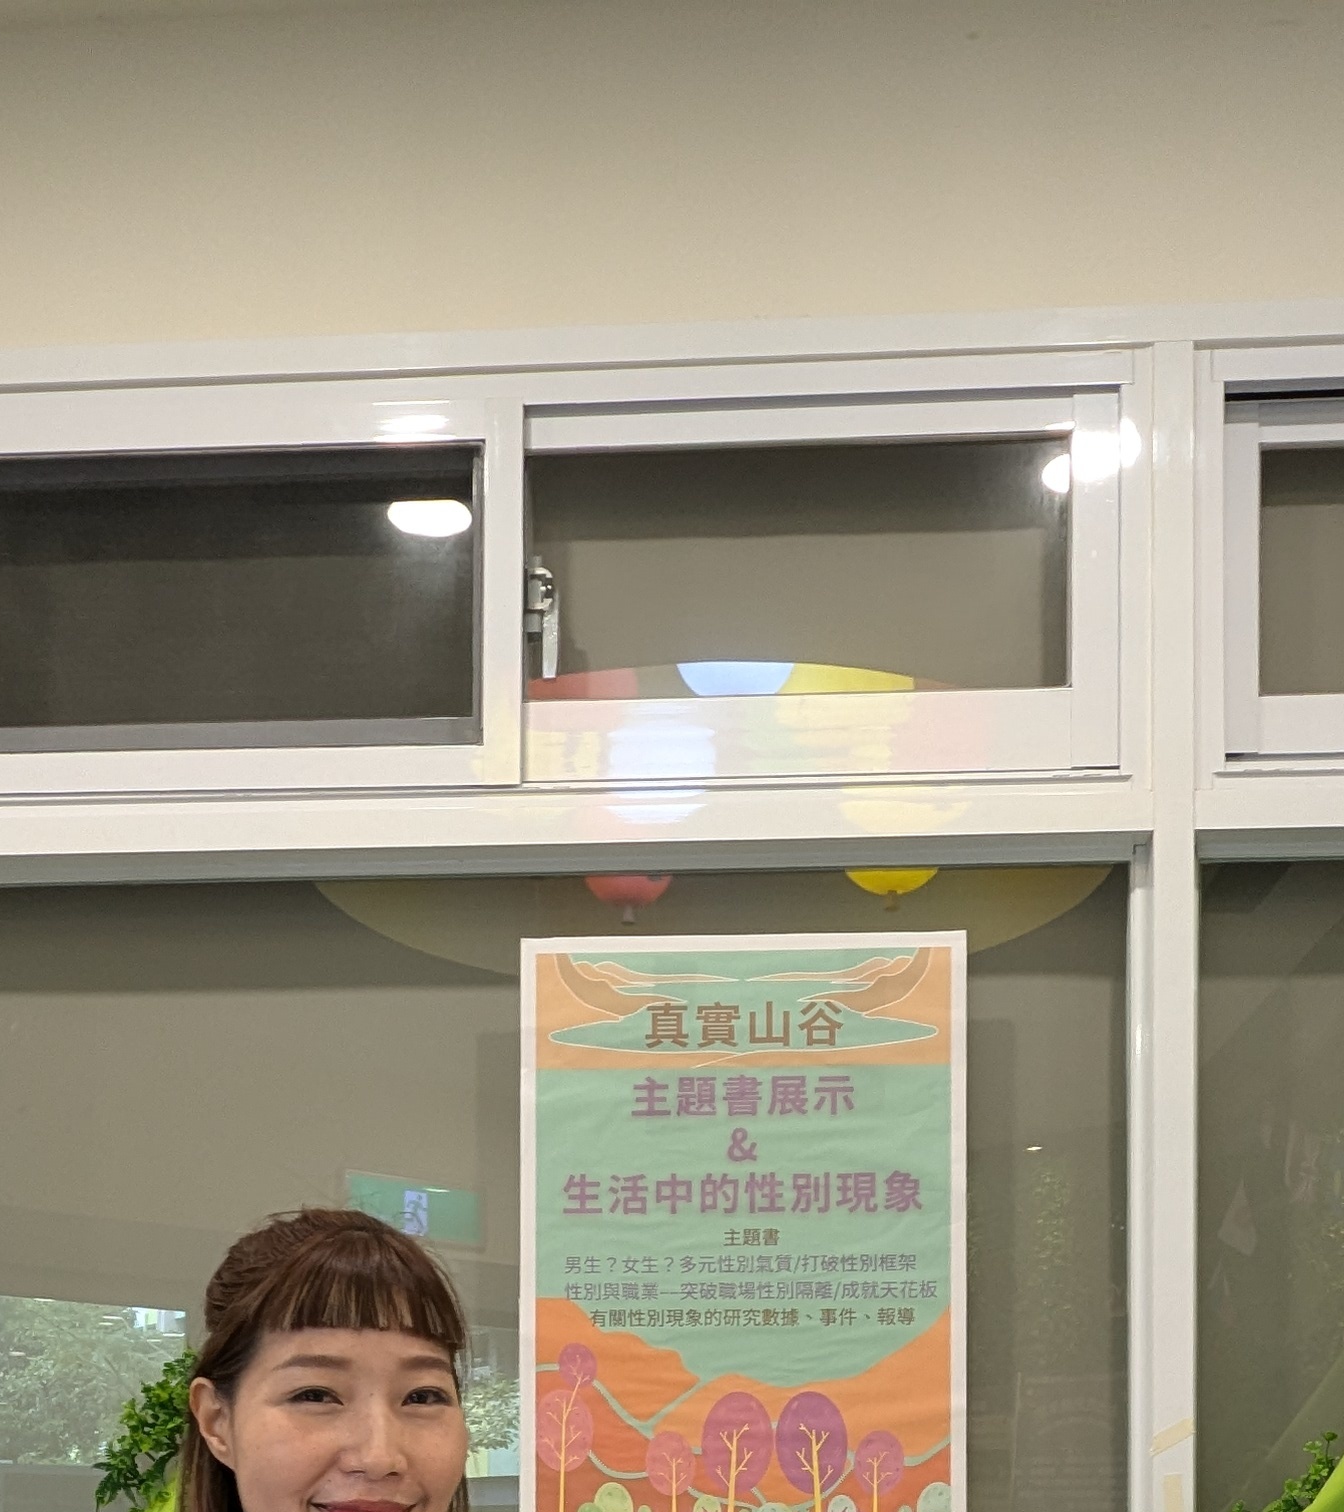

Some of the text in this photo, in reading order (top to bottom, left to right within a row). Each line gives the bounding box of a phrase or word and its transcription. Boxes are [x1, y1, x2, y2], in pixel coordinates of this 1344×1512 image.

[645, 1001, 844, 1048] 真實山谷
[631, 1074, 856, 1117] 主題書展示
[727, 1127, 758, 1162] &
[562, 1170, 922, 1215] 生活中的性別現象
[723, 1228, 780, 1246] 主題書
